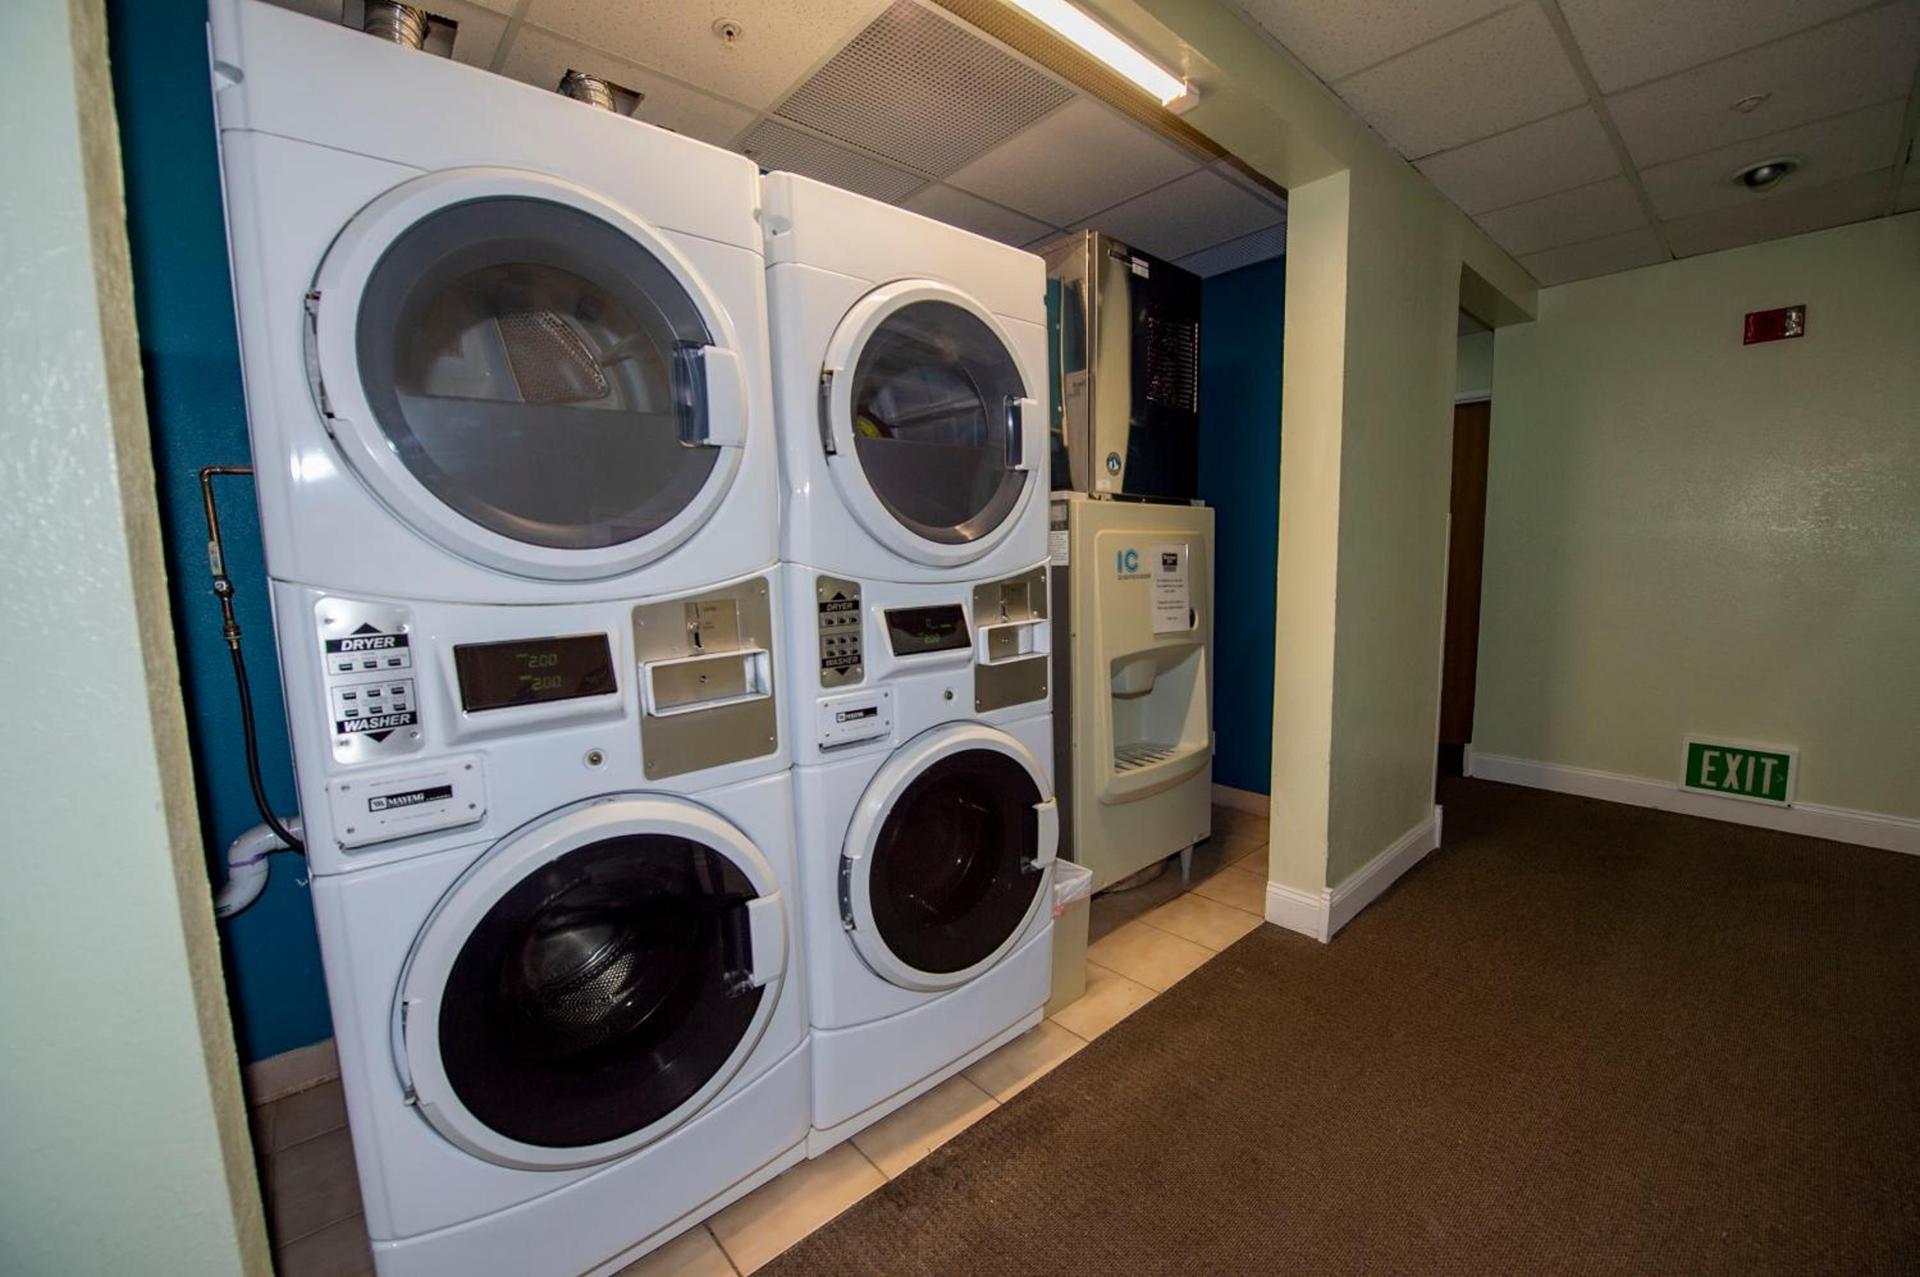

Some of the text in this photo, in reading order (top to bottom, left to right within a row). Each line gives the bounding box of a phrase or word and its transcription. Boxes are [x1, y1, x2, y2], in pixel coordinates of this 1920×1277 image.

[826, 602, 853, 611] DRYER
[341, 636, 395, 651] DRYER
[826, 656, 858, 667] WASHER
[343, 714, 411, 731] WASHER
[1700, 750, 1779, 795] EXIT
[388, 793, 425, 805] MAYTAG
